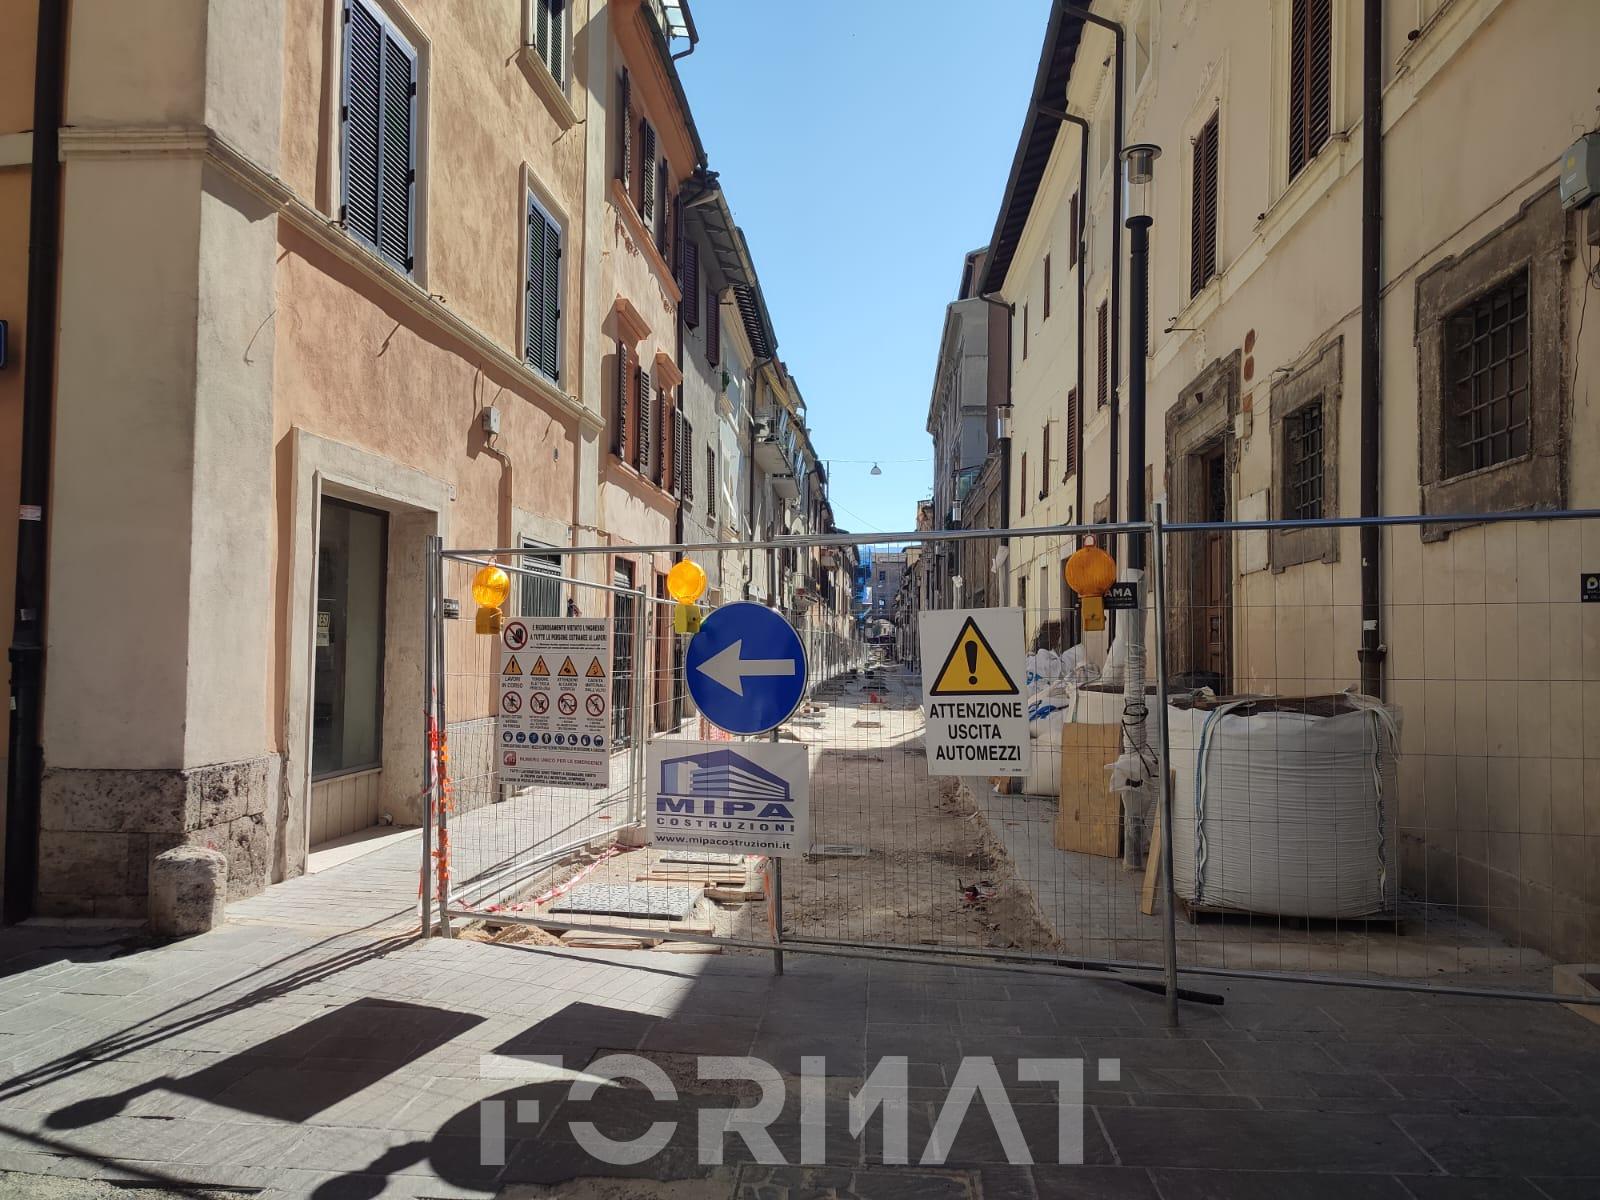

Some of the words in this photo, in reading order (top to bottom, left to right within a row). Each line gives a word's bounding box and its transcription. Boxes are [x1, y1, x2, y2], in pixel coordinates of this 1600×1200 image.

[567, 624, 582, 632] VIETATO
[533, 633, 545, 641] TUTTE
[551, 633, 569, 641] PERSONE
[929, 702, 1023, 719] ATTENZIONE
[947, 724, 1002, 740] USCITA
[936, 745, 1021, 761] AUTOMEZZI
[656, 797, 794, 818] MIPA
[656, 817, 795, 832] COSTRUZIONI
[656, 834, 791, 850] www.mipacostruzioni.it
